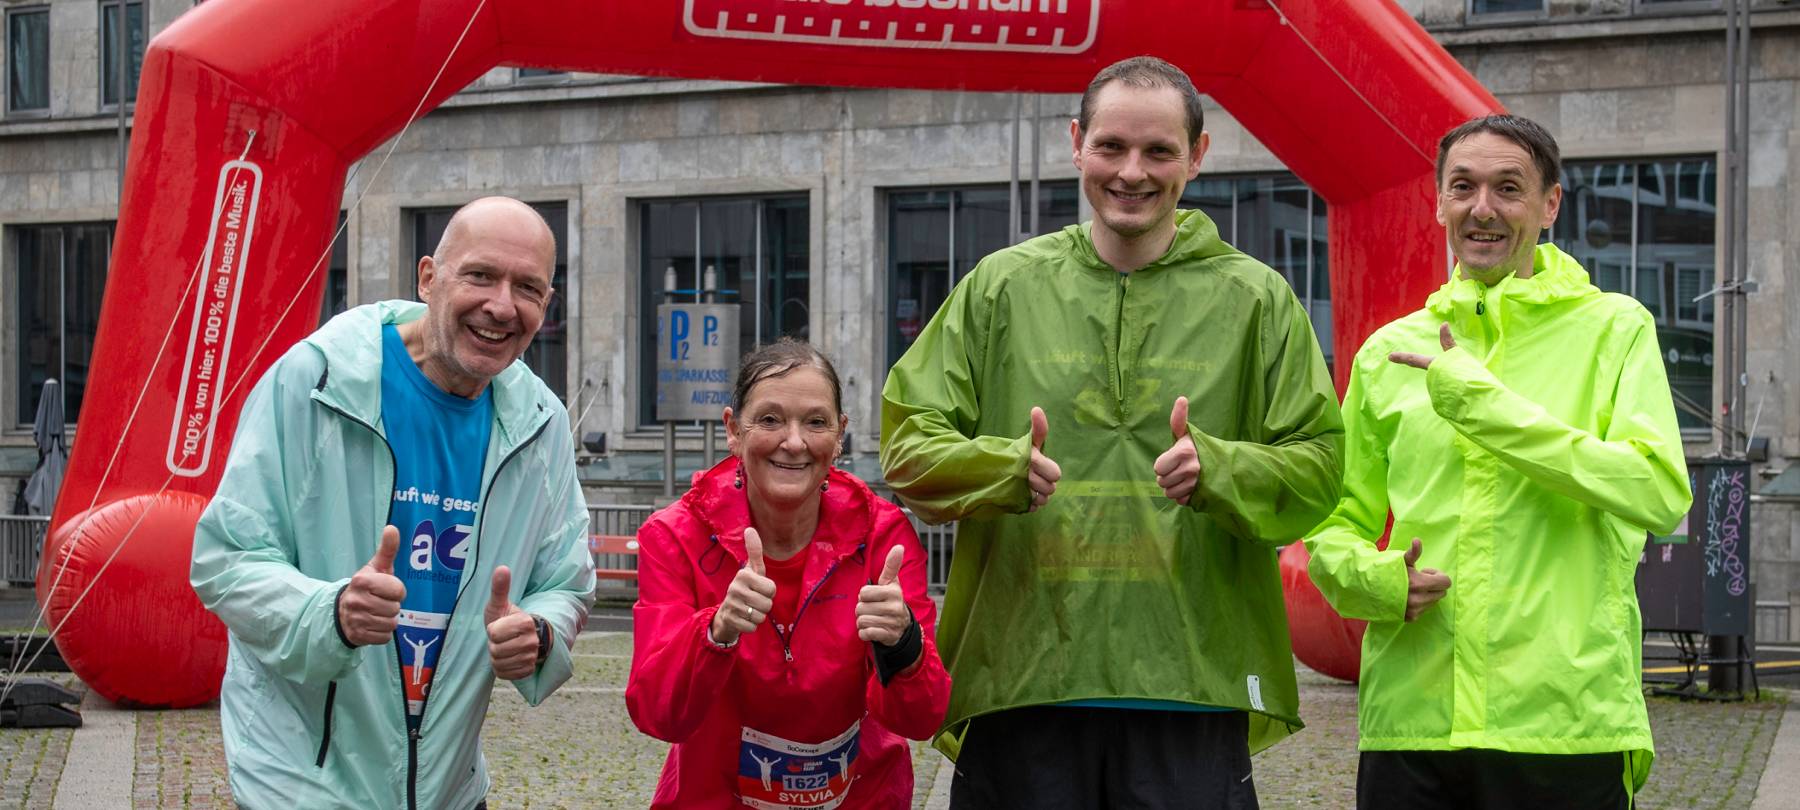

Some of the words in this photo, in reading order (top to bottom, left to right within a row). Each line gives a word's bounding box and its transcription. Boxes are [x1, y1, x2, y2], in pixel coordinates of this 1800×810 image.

[225, 180, 248, 229] Musik.
[217, 231, 238, 274] beste
[214, 276, 229, 299] die
[204, 300, 225, 345] 100%
[675, 368, 730, 383] SPARKASSE
[195, 383, 209, 409] von
[182, 414, 204, 456] 100%
[394, 486, 419, 503] uft
[421, 489, 440, 506] wie
[785, 774, 828, 790] 1622
[779, 789, 834, 803] SYLVIA
